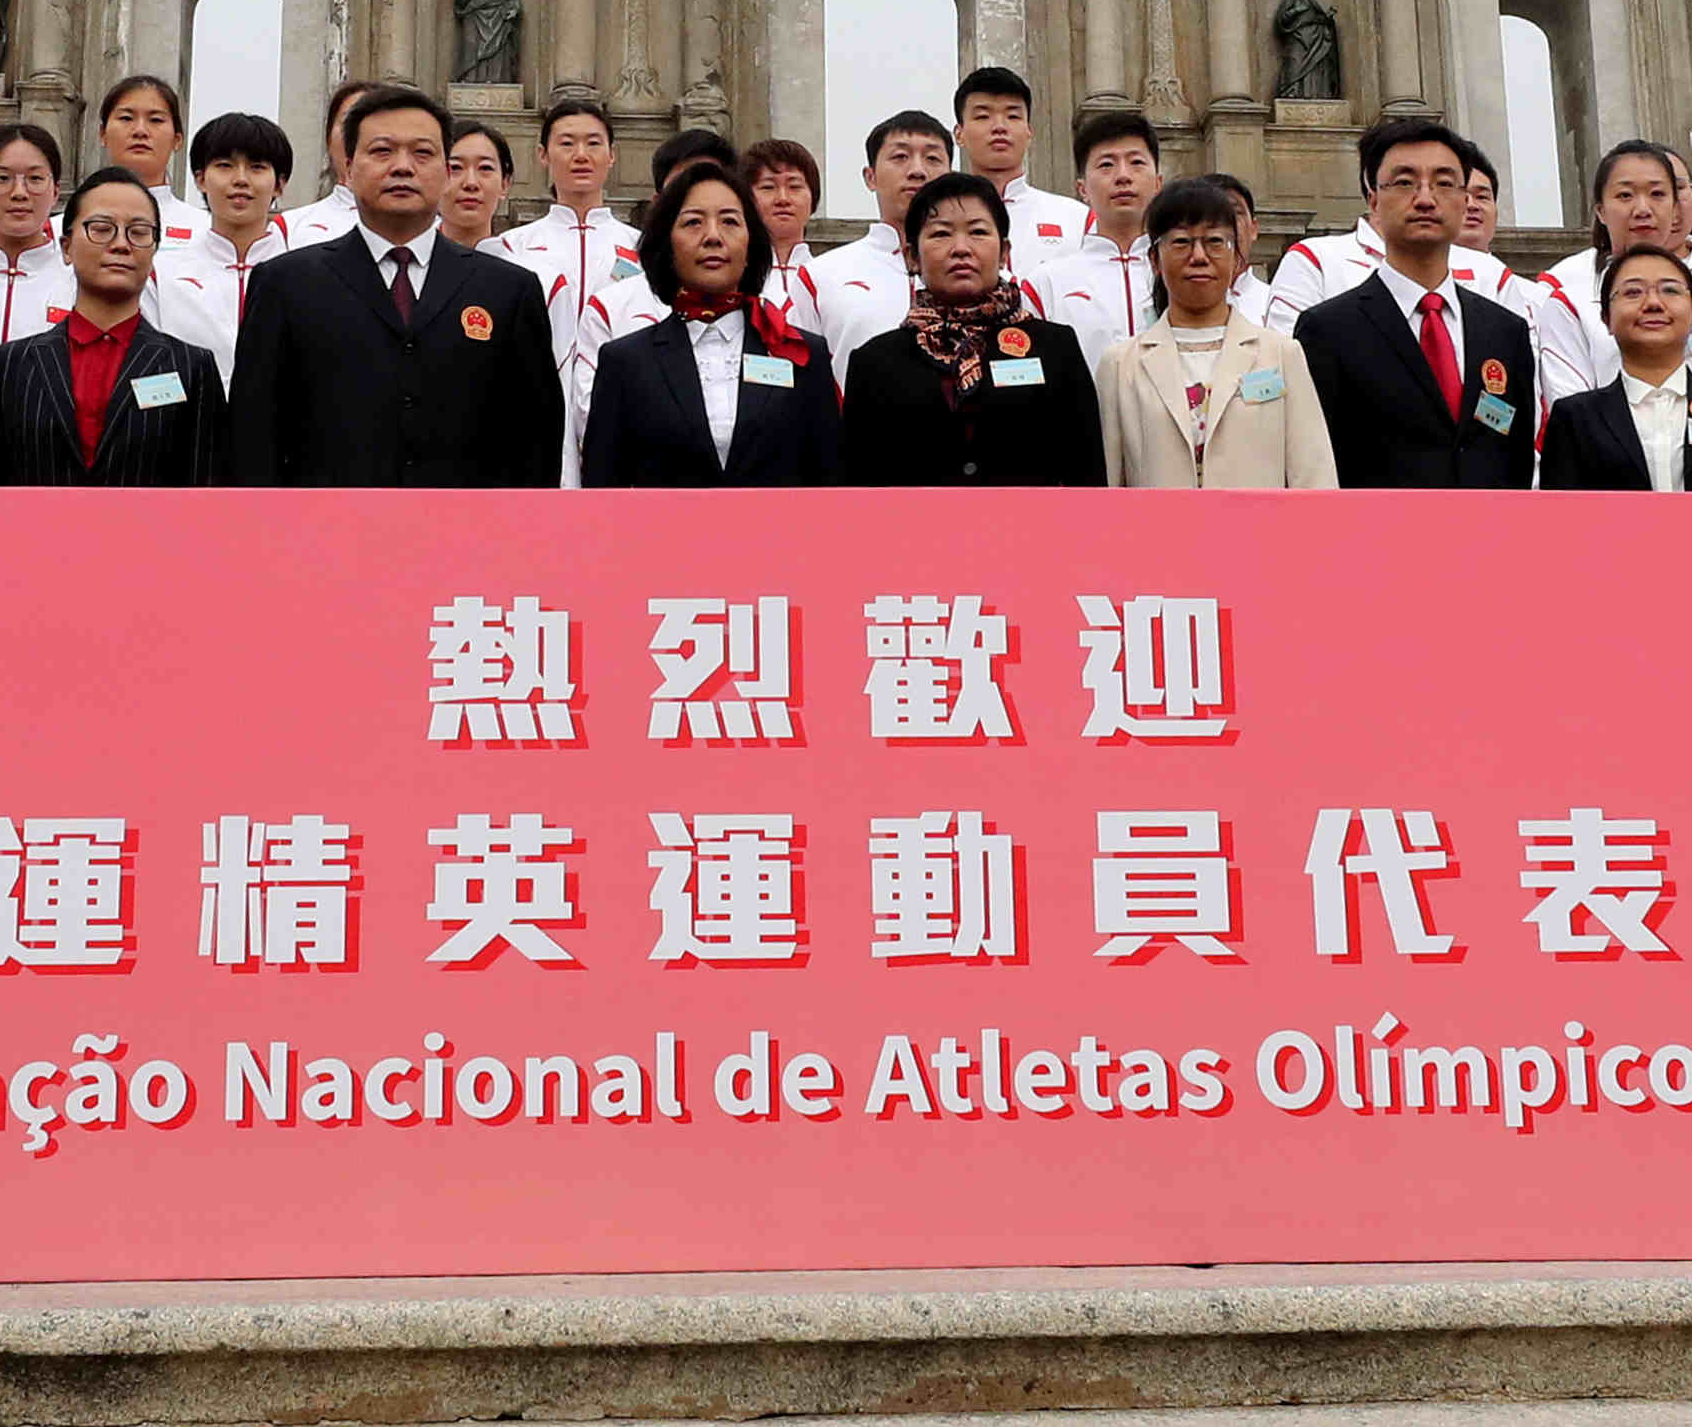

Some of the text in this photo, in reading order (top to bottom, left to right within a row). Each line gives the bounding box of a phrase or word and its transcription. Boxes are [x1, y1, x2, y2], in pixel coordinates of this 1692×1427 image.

[427, 595, 1231, 744] 熱烈歡迎
[225, 1031, 685, 1124] Nacional
[714, 1030, 836, 1117] de
[864, 1028, 1227, 1115] Atletas
